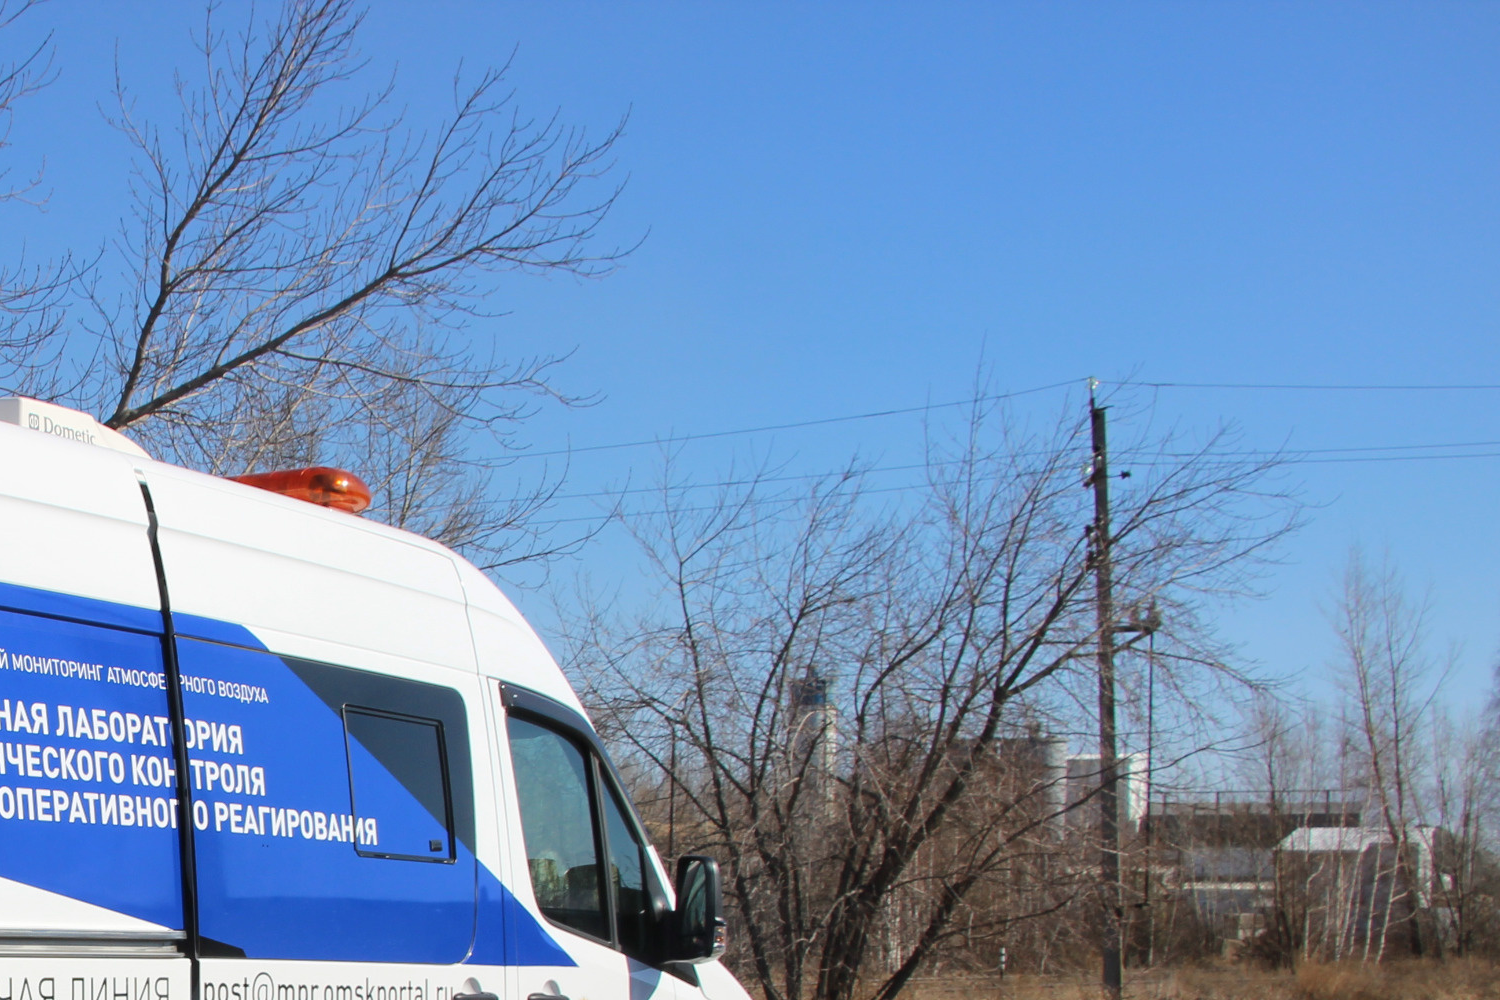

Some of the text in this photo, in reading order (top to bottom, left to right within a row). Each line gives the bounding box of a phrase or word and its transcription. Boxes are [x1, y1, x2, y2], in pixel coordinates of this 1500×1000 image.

[43, 416, 96, 445] Dometic
[12, 653, 103, 682] МОНИТОРИНГ
[218, 680, 269, 704] ВОЗДУХА
[56, 705, 244, 755] ЛАБОРАТОРИЯ
[130, 754, 266, 796] КОНТРОЛЯ
[214, 801, 378, 847] РЕАГИРОВАНИЯ
